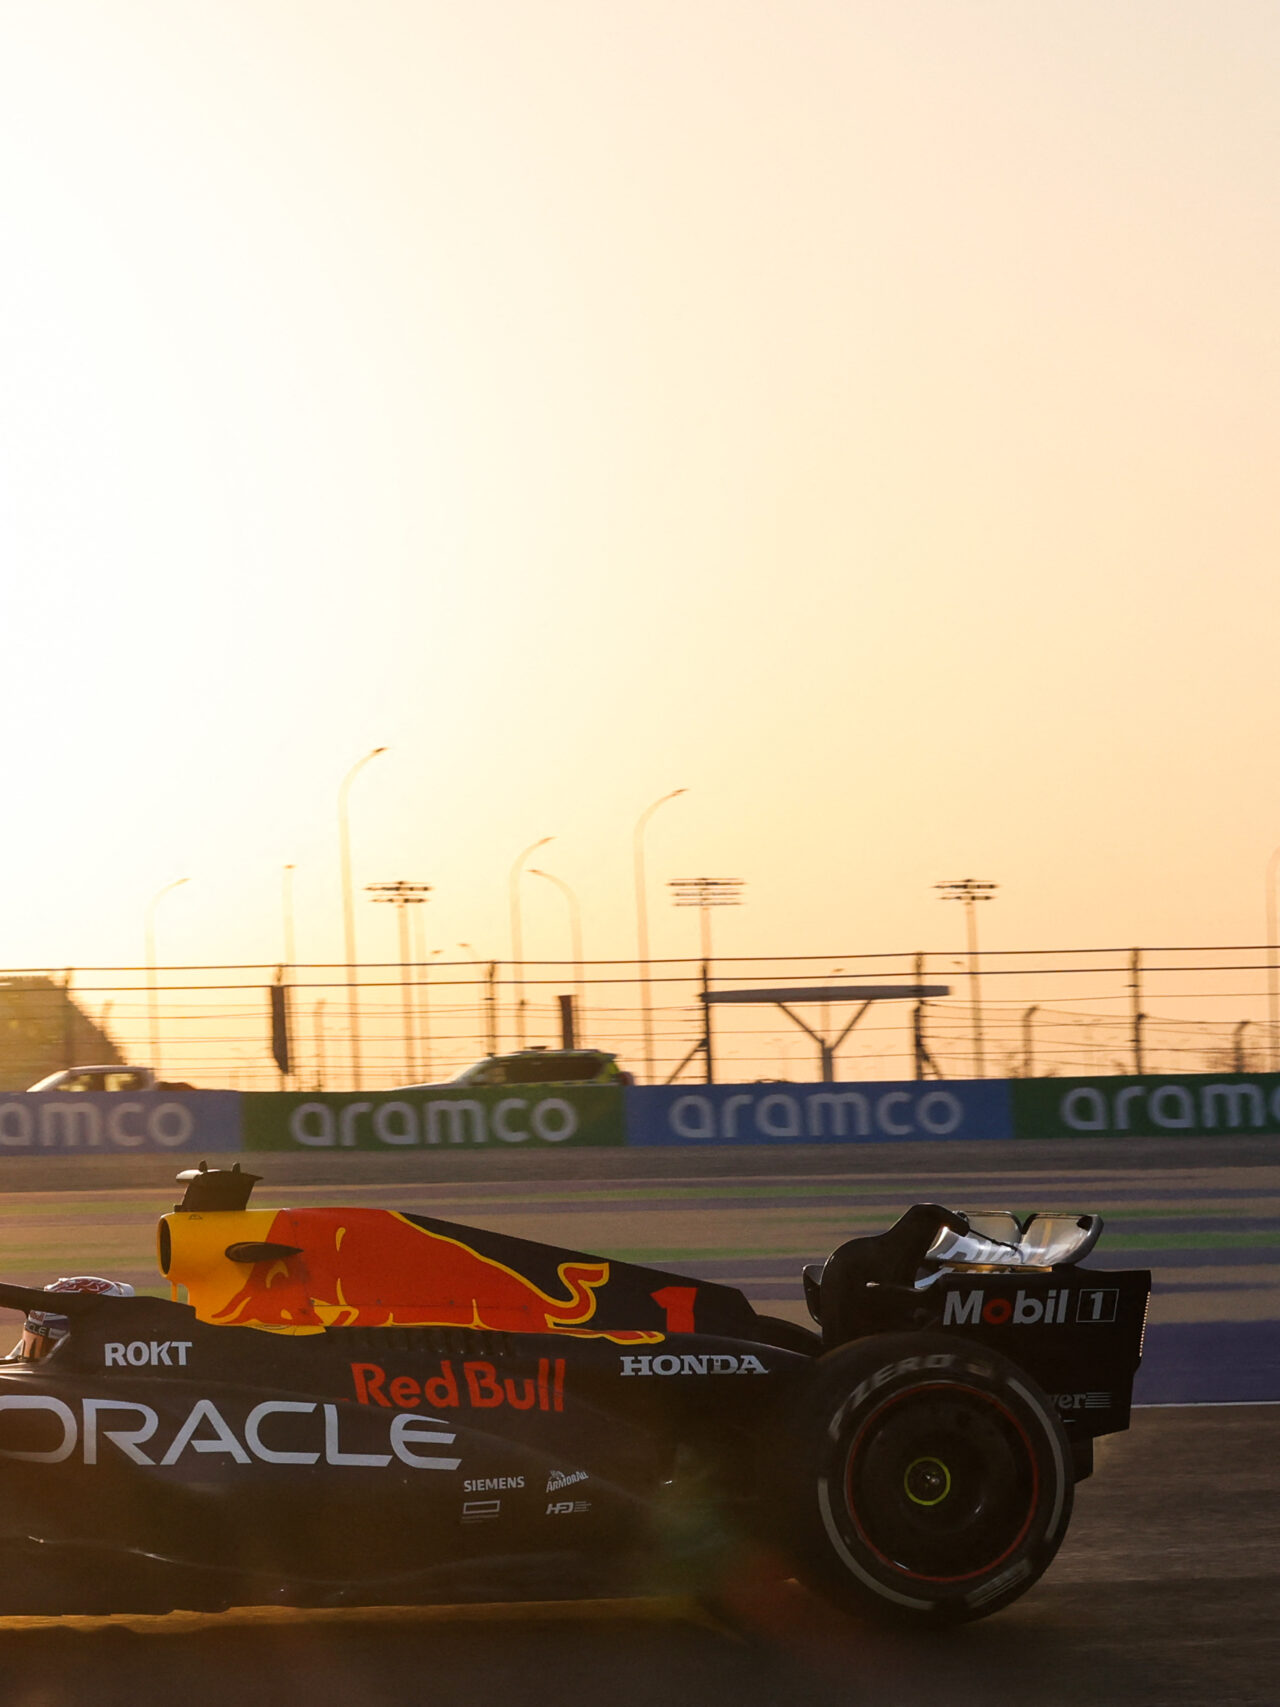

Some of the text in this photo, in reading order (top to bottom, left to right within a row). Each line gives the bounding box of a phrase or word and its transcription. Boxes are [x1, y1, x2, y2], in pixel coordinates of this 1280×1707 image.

[290, 1098, 578, 1146] aramco
[671, 1091, 963, 1138] aramco
[1060, 1083, 1280, 1130] aram
[650, 1286, 697, 1333] 1
[943, 1289, 1104, 1325] Mobil 1
[105, 1341, 193, 1367] ROKT
[620, 1354, 769, 1376] HONDA
[351, 1358, 565, 1412] Red Bull
[464, 1476, 525, 1492] SIEMENS
